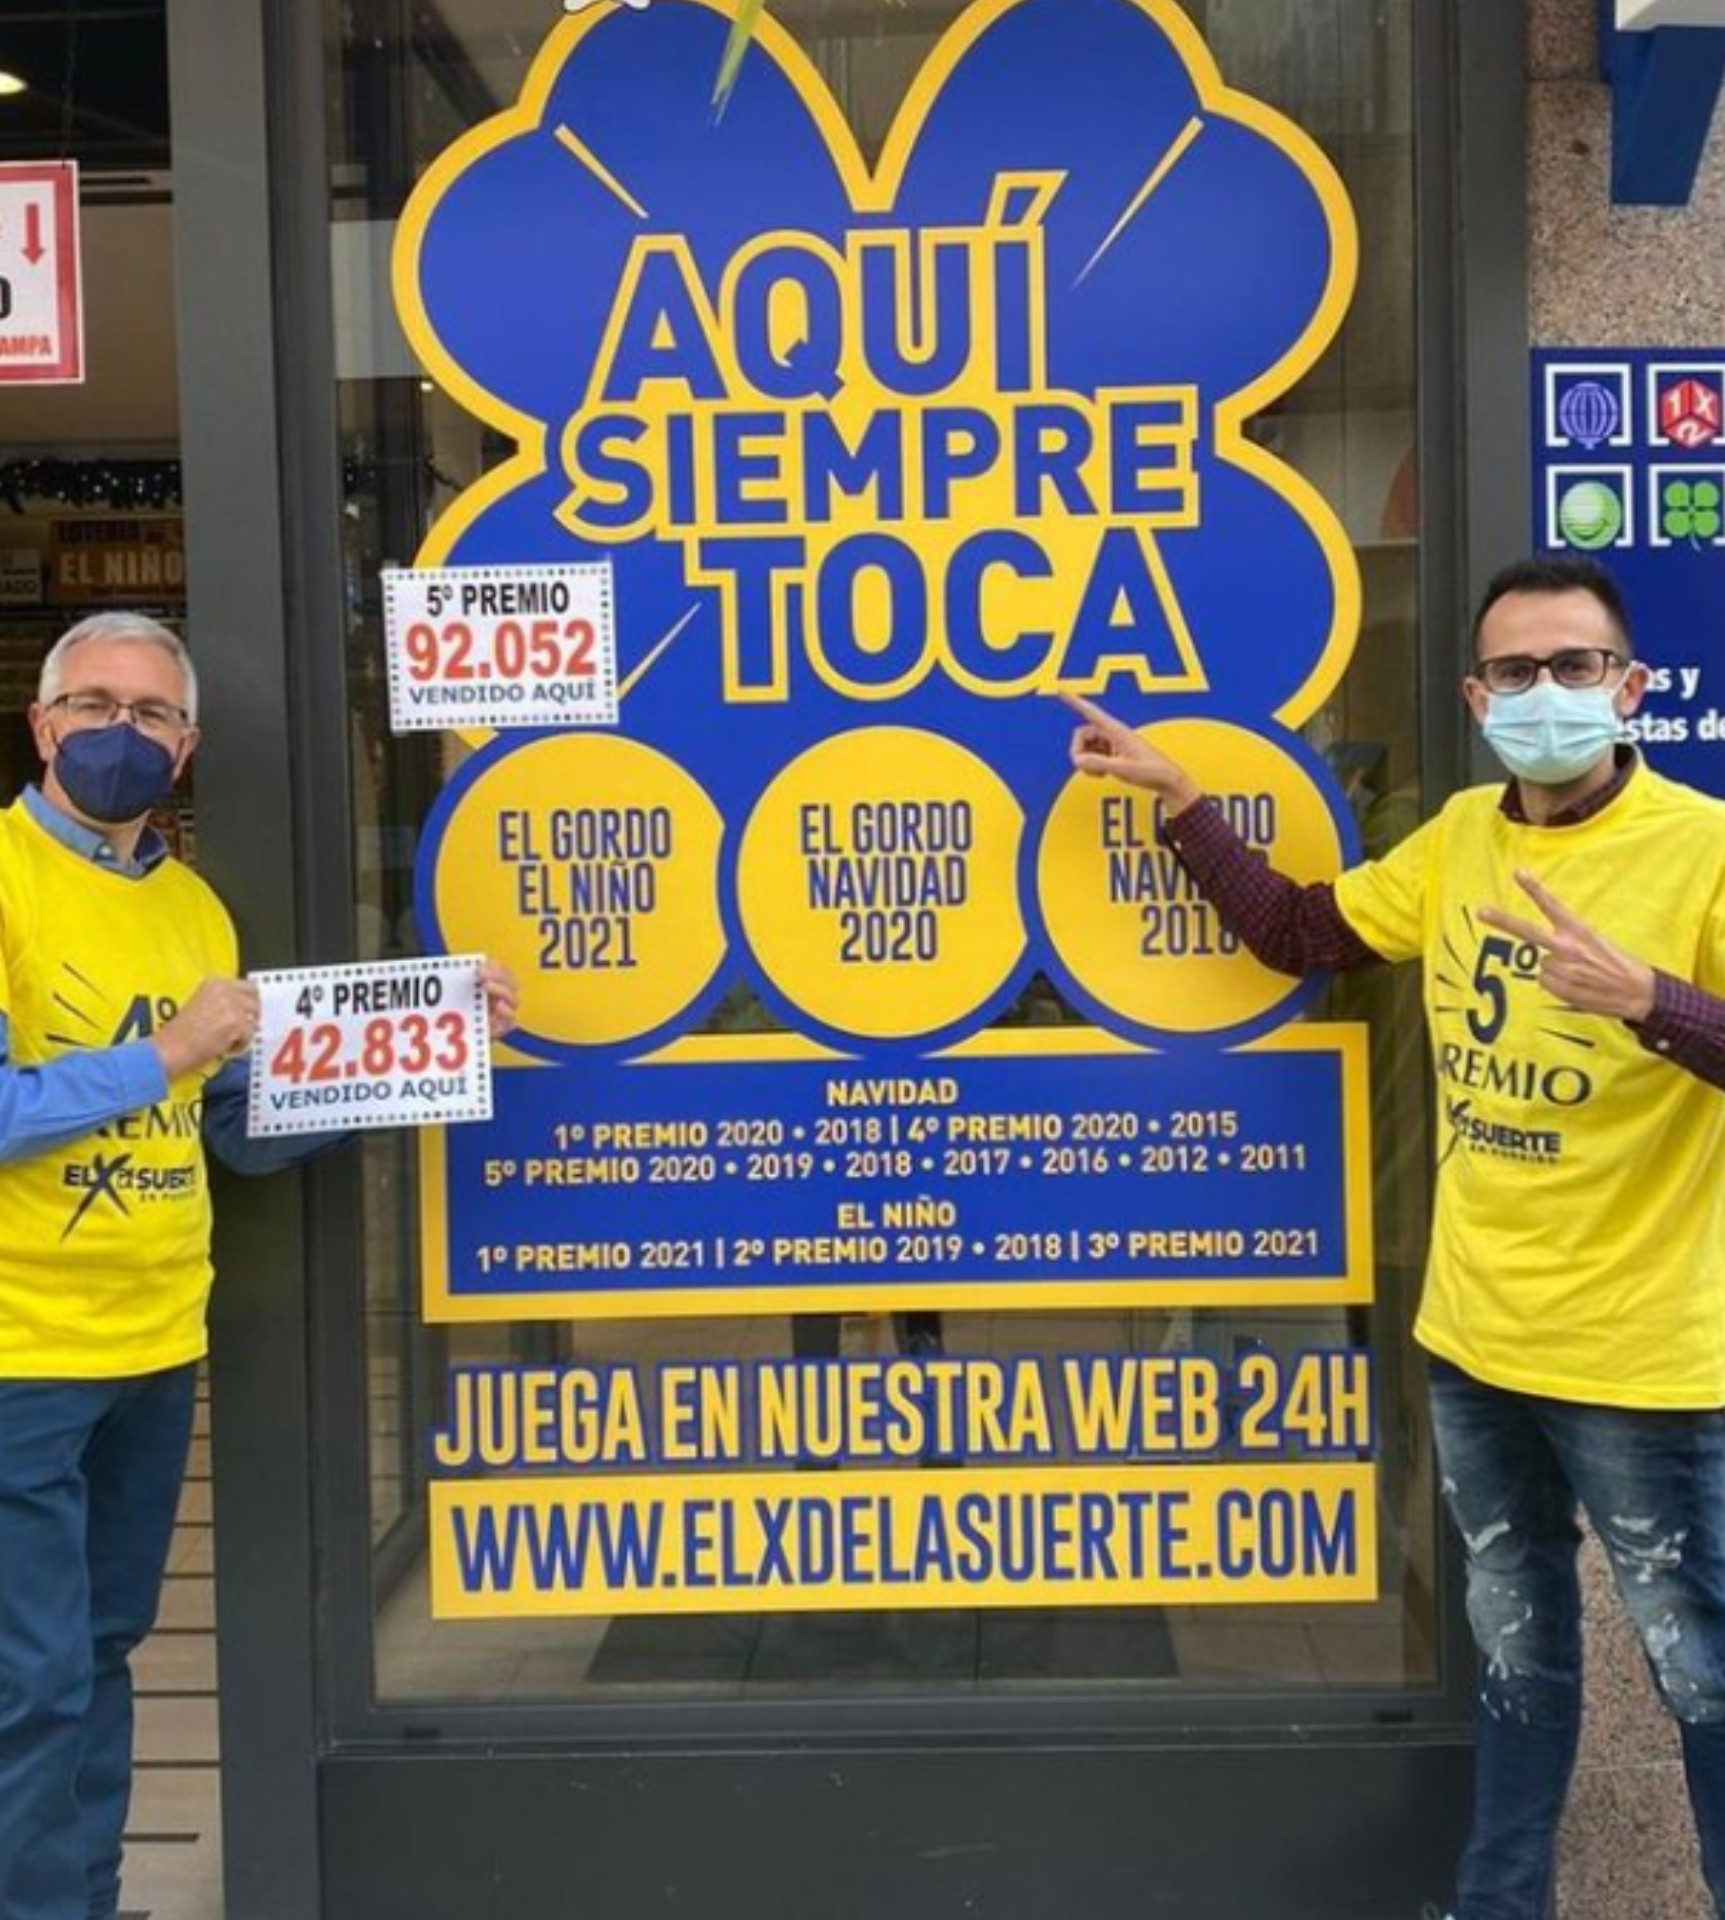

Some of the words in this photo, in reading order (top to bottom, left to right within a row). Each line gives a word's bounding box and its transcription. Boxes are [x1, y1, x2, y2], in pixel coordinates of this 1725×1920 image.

[590, 174, 1052, 404] AQUÍ
[566, 399, 1190, 531] SIEMPRE
[60, 552, 94, 585] EL
[103, 545, 183, 585] NIÑO
[427, 584, 453, 617] 5º
[461, 581, 571, 616] PREMIO
[696, 525, 1195, 692] TOCA
[405, 618, 597, 682] 92.052
[409, 683, 525, 704] VENDIDO
[1680, 667, 1700, 700] y
[500, 810, 541, 862] EL
[551, 807, 672, 860] GORDO
[801, 804, 842, 856] EL
[852, 801, 972, 855] GORDO
[1102, 796, 1143, 849] EL
[519, 865, 560, 915] EL
[570, 857, 655, 914] NIÑO
[809, 856, 967, 909] NAVIDAD
[539, 917, 637, 969] 2021
[840, 910, 938, 962] 2020
[295, 984, 325, 1020] 4º
[332, 976, 443, 1016] PREMIO
[1466, 934, 1541, 1045] 5º
[270, 1010, 469, 1084] 42.833
[270, 1082, 392, 1111] VENDIDO
[826, 1078, 959, 1107] NAVIDAD
[1438, 1042, 1592, 1107] REMIO
[555, 1124, 584, 1151] 1º
[593, 1121, 708, 1150] PREMIO
[716, 1119, 782, 1146] 2020
[815, 1117, 882, 1144] 2018
[907, 1116, 939, 1142] 4º
[948, 1113, 1062, 1141] PREMIO
[1070, 1113, 1139, 1140] 2020
[1169, 1111, 1238, 1138] 2015
[1470, 1117, 1562, 1153] SUERTE
[484, 1159, 516, 1186] 5º
[524, 1156, 639, 1185] PREMIO
[649, 1155, 716, 1181] 2020
[746, 1153, 812, 1180] 2019
[845, 1151, 912, 1178] 2018
[943, 1148, 1010, 1176] 2017
[1042, 1147, 1109, 1174] 2016
[1140, 1145, 1209, 1172] 2012
[1240, 1144, 1306, 1171] 2011
[837, 1202, 874, 1230] EL
[883, 1194, 957, 1229] NIÑO
[477, 1245, 508, 1272] 1º
[516, 1243, 631, 1271] PREMIO
[640, 1241, 705, 1268] 2021
[733, 1239, 765, 1267] 2º
[774, 1236, 888, 1265] PREMIO
[896, 1235, 963, 1263] 2019
[994, 1232, 1062, 1261] 2018
[1088, 1232, 1120, 1259] 3º
[1128, 1230, 1245, 1258] PREMIO
[1253, 1229, 1319, 1257] 2021
[433, 1367, 646, 1467] JUEGA
[660, 1364, 740, 1460] EN
[758, 1358, 1053, 1458] NUESTRA
[1063, 1358, 1220, 1452] WEB
[1237, 1353, 1370, 1448] 24H
[450, 1487, 1358, 1593] WWW.ELXDELASUERTE.COM
